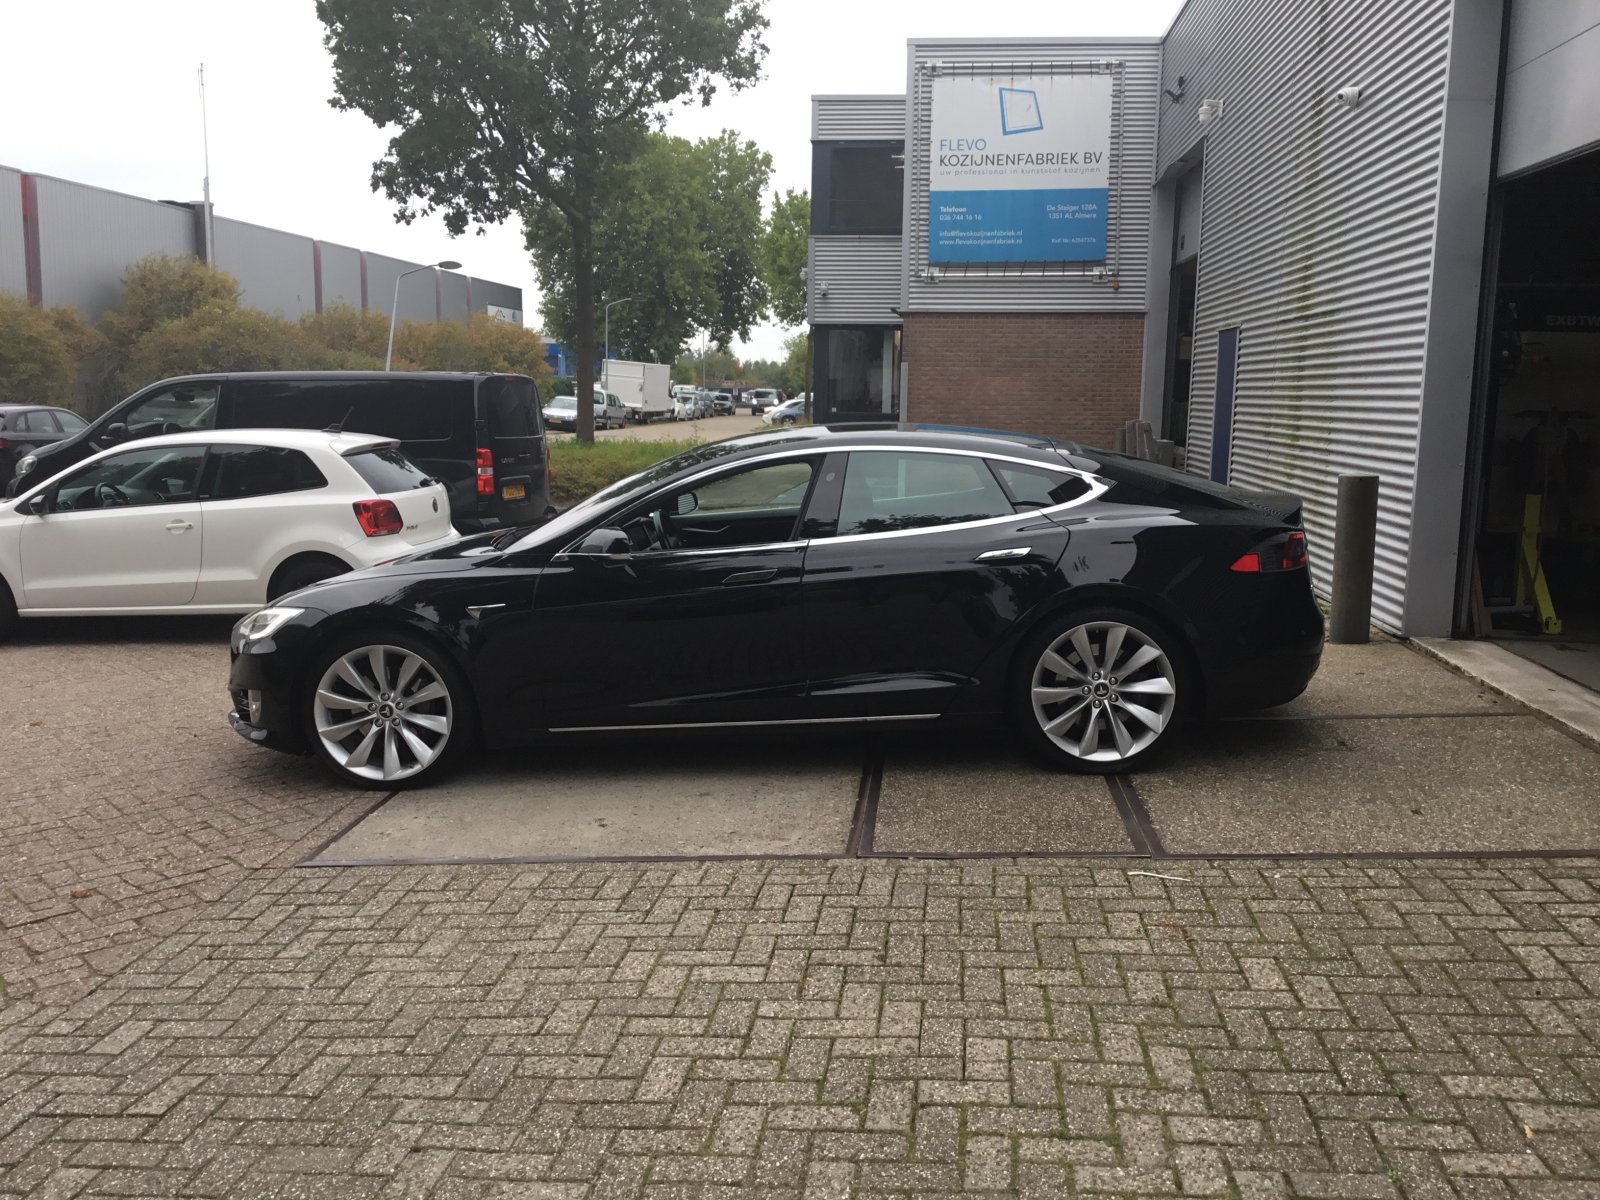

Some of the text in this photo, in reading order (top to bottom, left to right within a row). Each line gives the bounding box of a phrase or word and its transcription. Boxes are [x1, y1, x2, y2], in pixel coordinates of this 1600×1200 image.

[940, 138, 987, 151] FLEVO
[939, 151, 1103, 167] KOZIJNENFABRIEK BV
[954, 168, 1007, 177] professional
[1010, 167, 1018, 175] in
[1021, 166, 1061, 175] kunststof
[1064, 166, 1101, 176] kozijnen
[939, 205, 967, 213] Telefoon
